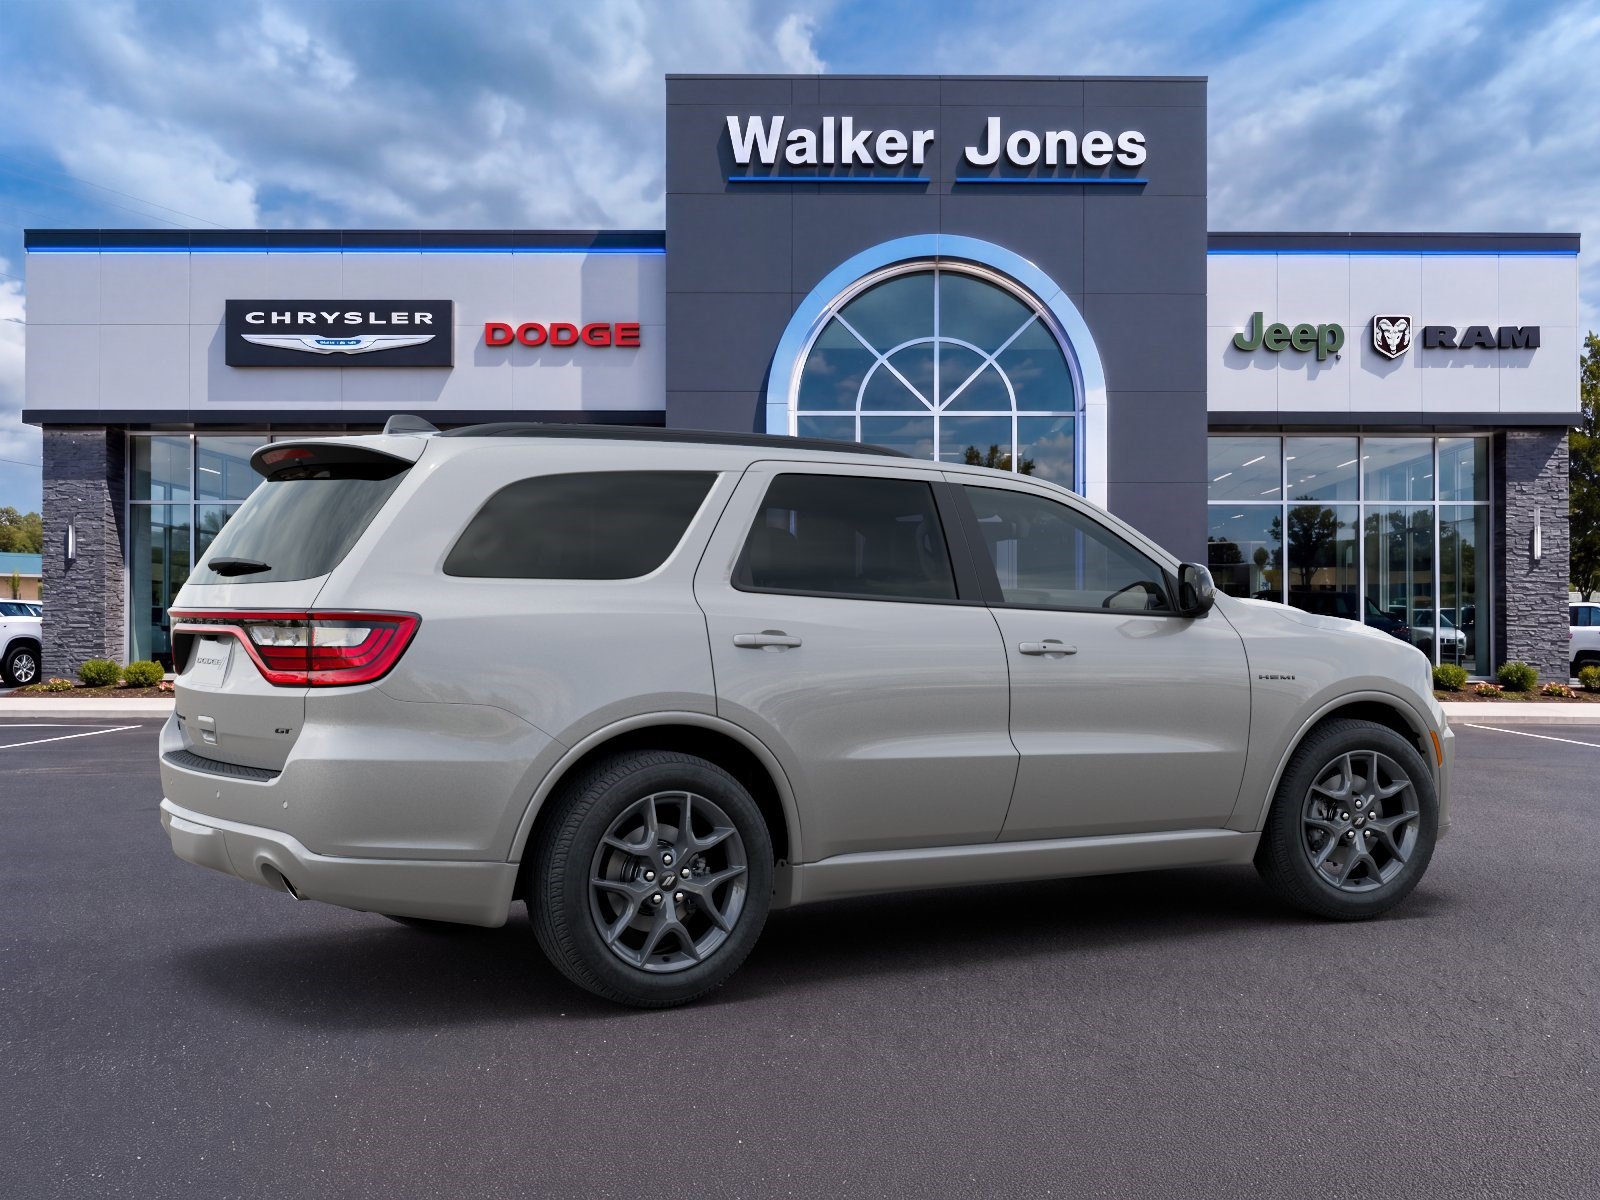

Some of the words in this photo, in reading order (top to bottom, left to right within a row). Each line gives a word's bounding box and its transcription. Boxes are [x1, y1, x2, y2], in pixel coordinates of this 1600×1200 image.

[726, 115, 935, 166] Walker
[964, 115, 1148, 167] Jones
[244, 311, 434, 326] CHRYSLER
[484, 321, 641, 348] DODGE
[1232, 311, 1345, 361] Jeep
[1423, 325, 1541, 349] RAM
[274, 727, 293, 735] GT
